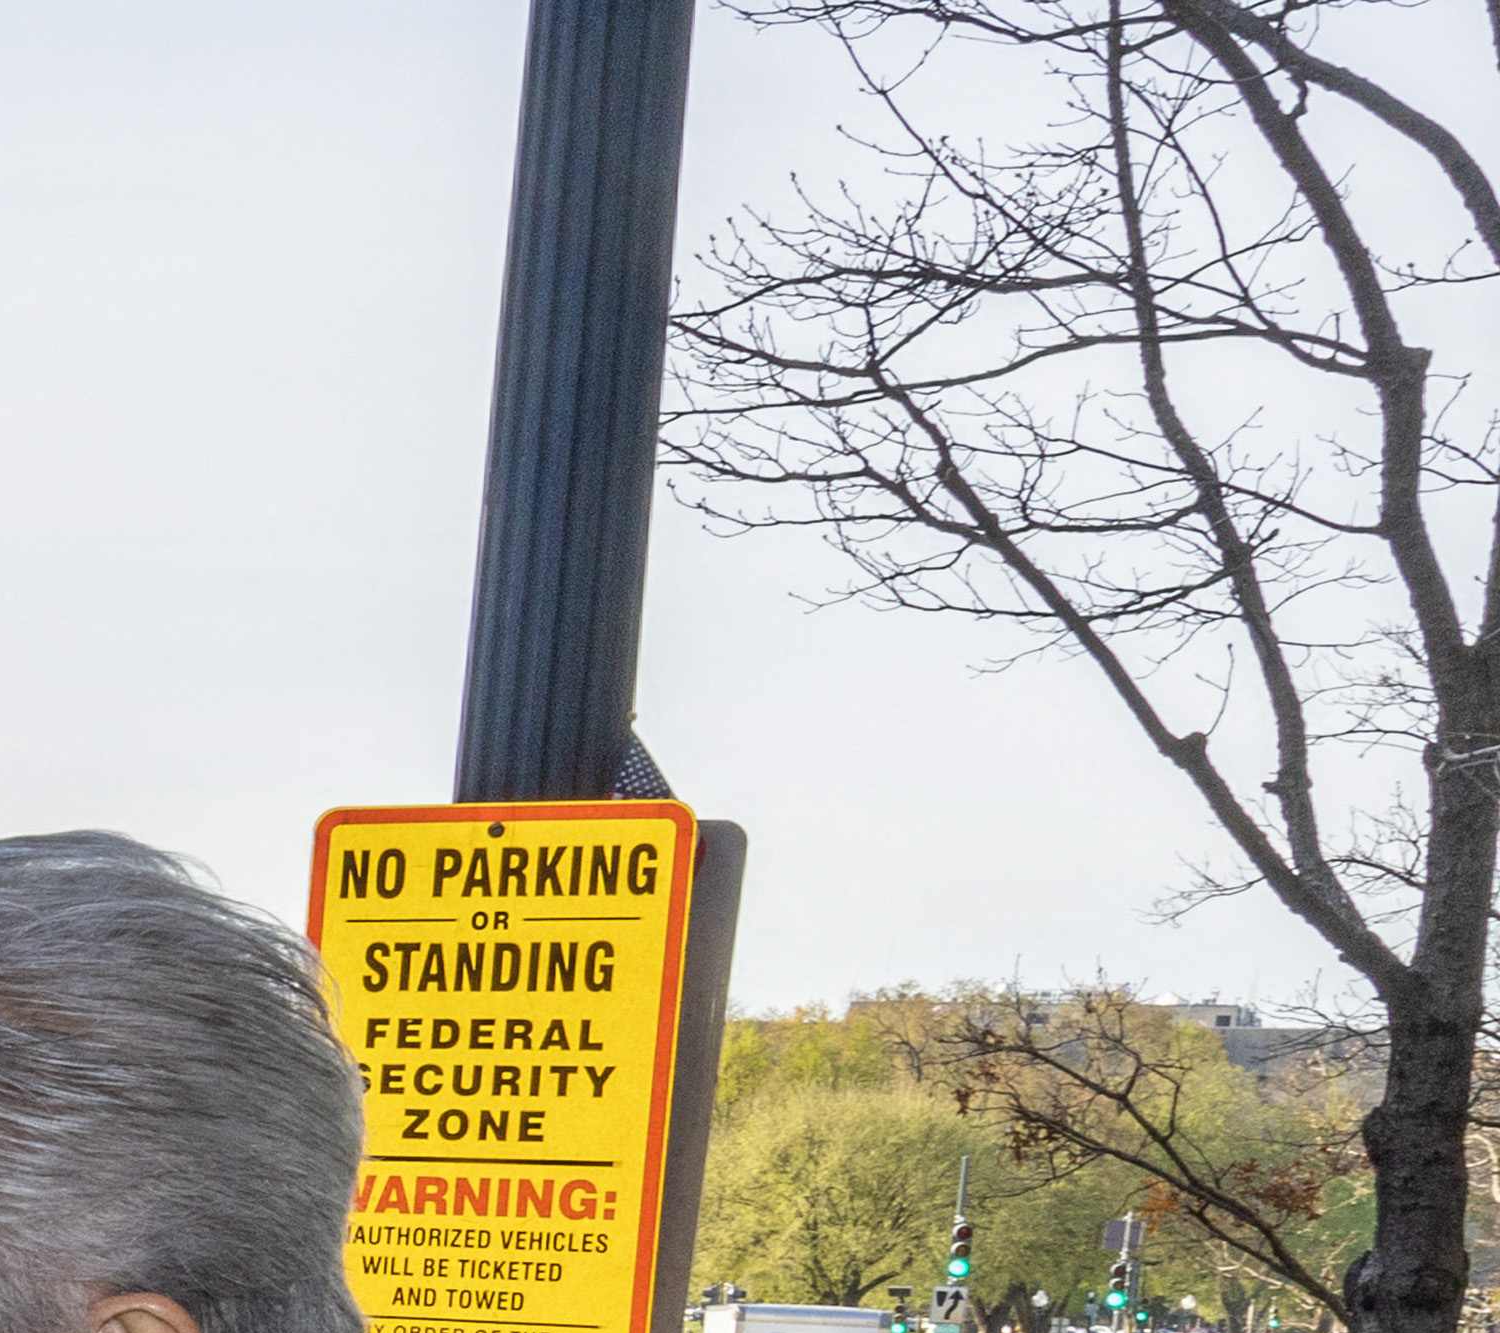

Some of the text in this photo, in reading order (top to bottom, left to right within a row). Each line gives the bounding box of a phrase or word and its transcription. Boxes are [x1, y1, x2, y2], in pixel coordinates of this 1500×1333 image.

[339, 843, 659, 899] NO PARKING
[471, 911, 510, 931] OR
[362, 940, 615, 993] STANDING
[364, 1018, 605, 1051] FEDERAL
[401, 1108, 546, 1142] ZONE
[348, 1225, 609, 1253] AUTHORIZED VEHICLES
[362, 1256, 563, 1283] WILL BE TICKETED
[391, 1287, 525, 1311] AND TOWED
